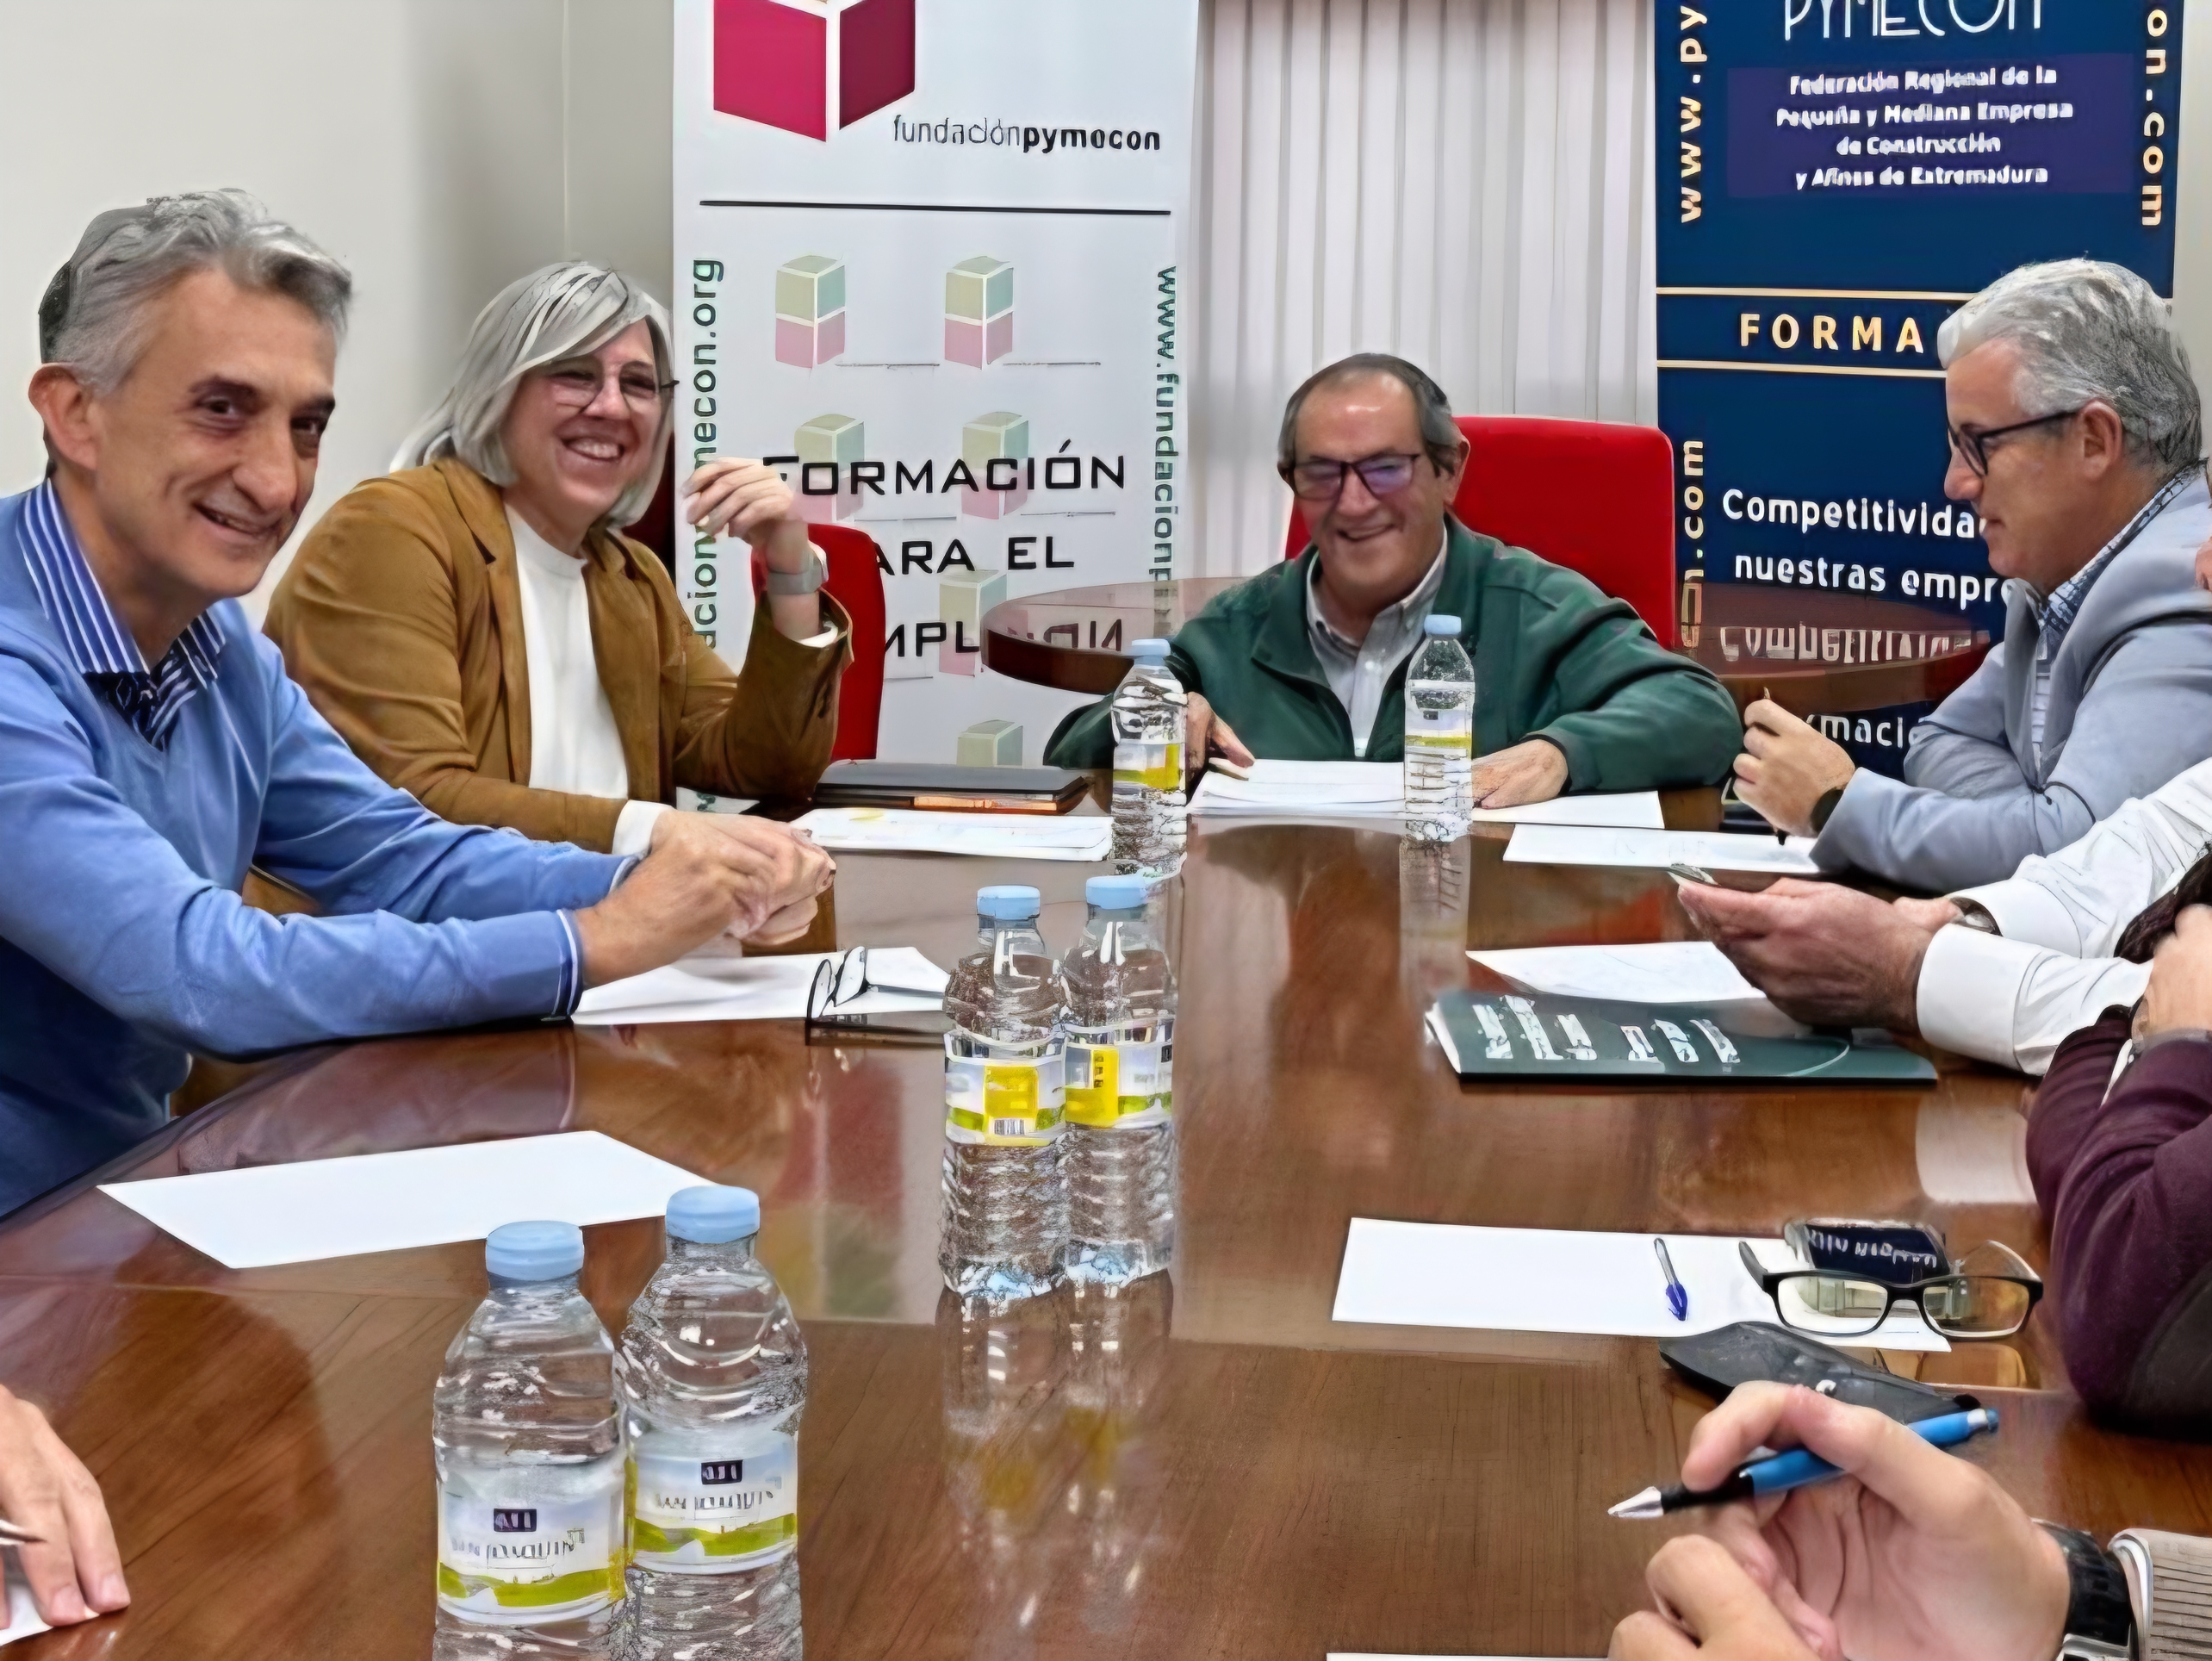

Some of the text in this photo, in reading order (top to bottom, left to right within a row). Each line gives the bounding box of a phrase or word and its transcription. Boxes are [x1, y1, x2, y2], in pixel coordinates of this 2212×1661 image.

[2001, 66, 2029, 85] de
[2035, 65, 2057, 84] la
[1866, 109, 1878, 128] y
[1884, 103, 1971, 124] Mediana
[1977, 102, 2073, 123] Empresa
[1836, 135, 1861, 156] de
[1795, 171, 1807, 190] y
[1880, 165, 1905, 185] de
[1911, 165, 2048, 185] Extremadura
[1740, 313, 1924, 354] FORMA
[1723, 488, 1986, 538] Competitivida
[873, 535, 1075, 576] ARA EL
[1735, 554, 1999, 611] nuestras empr
